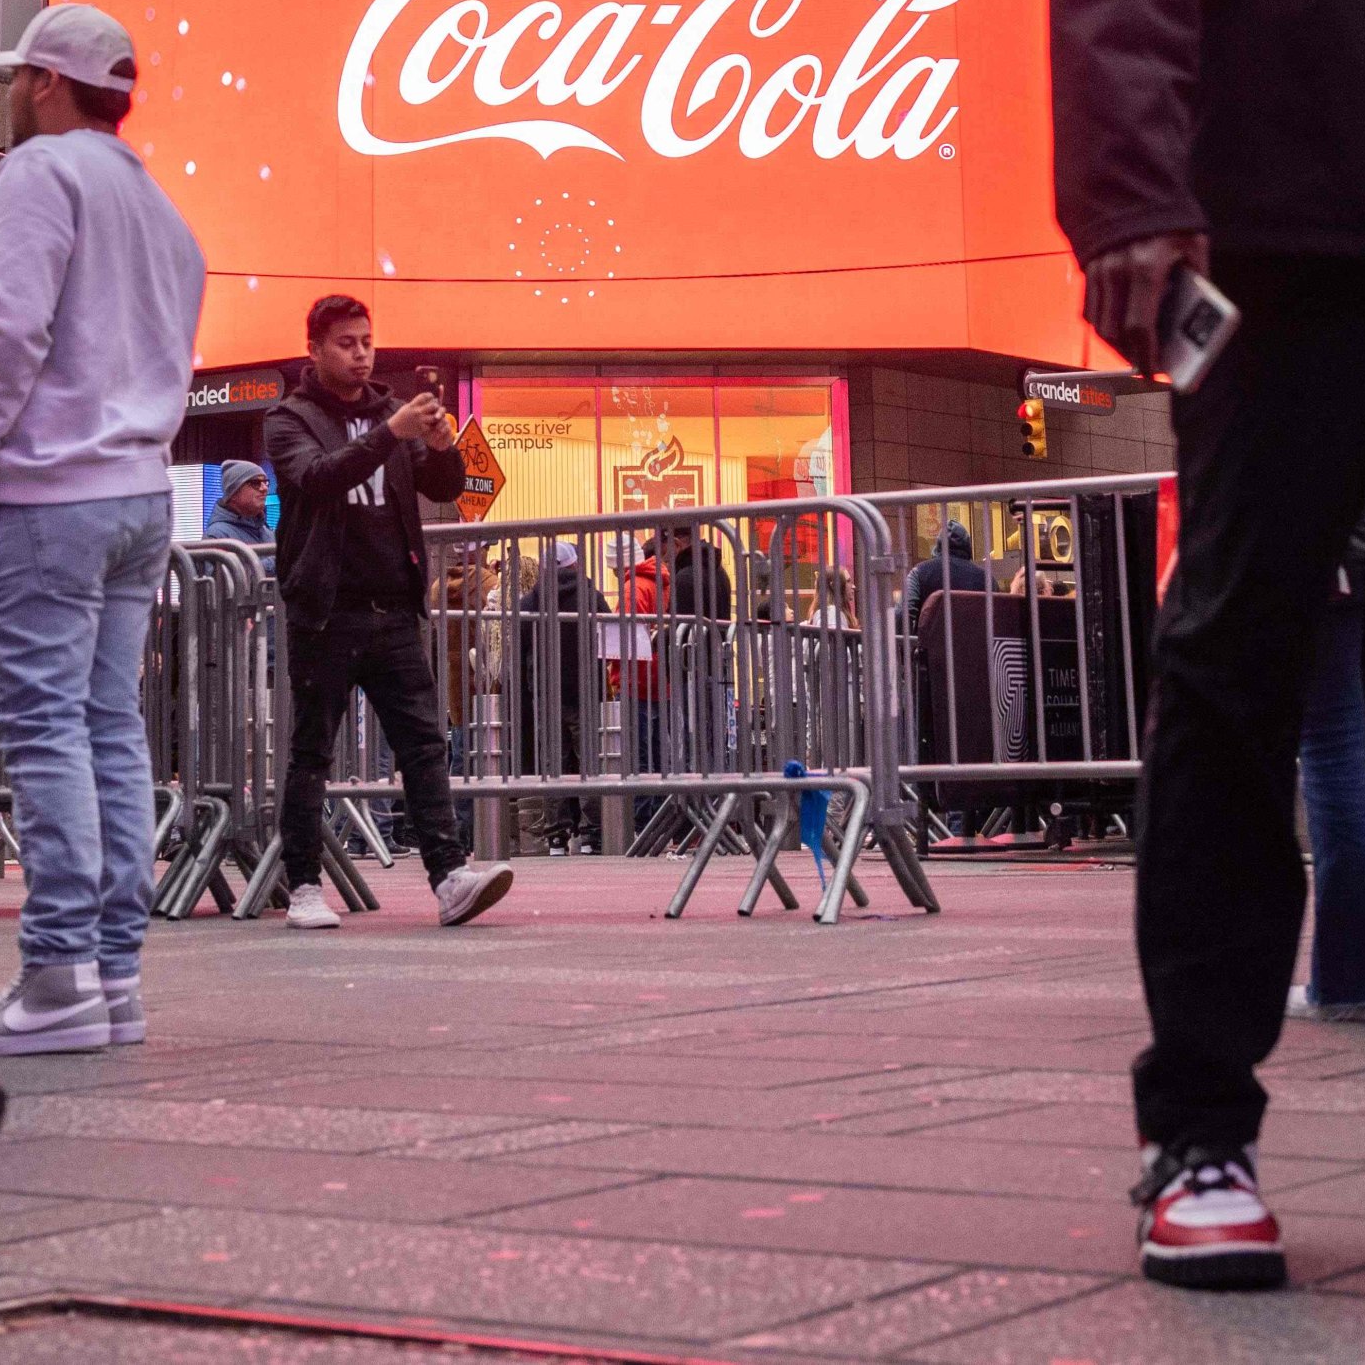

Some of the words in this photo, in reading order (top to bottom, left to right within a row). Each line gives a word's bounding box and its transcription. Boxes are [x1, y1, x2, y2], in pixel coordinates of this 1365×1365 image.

[185, 378, 279, 407] ndedcities
[487, 421, 531, 436] cross
[534, 420, 572, 436] river
[487, 437, 553, 452] campus
[475, 478, 494, 493] ZONE
[461, 496, 487, 507] AHEAD
[1048, 668, 1079, 688] TIME
